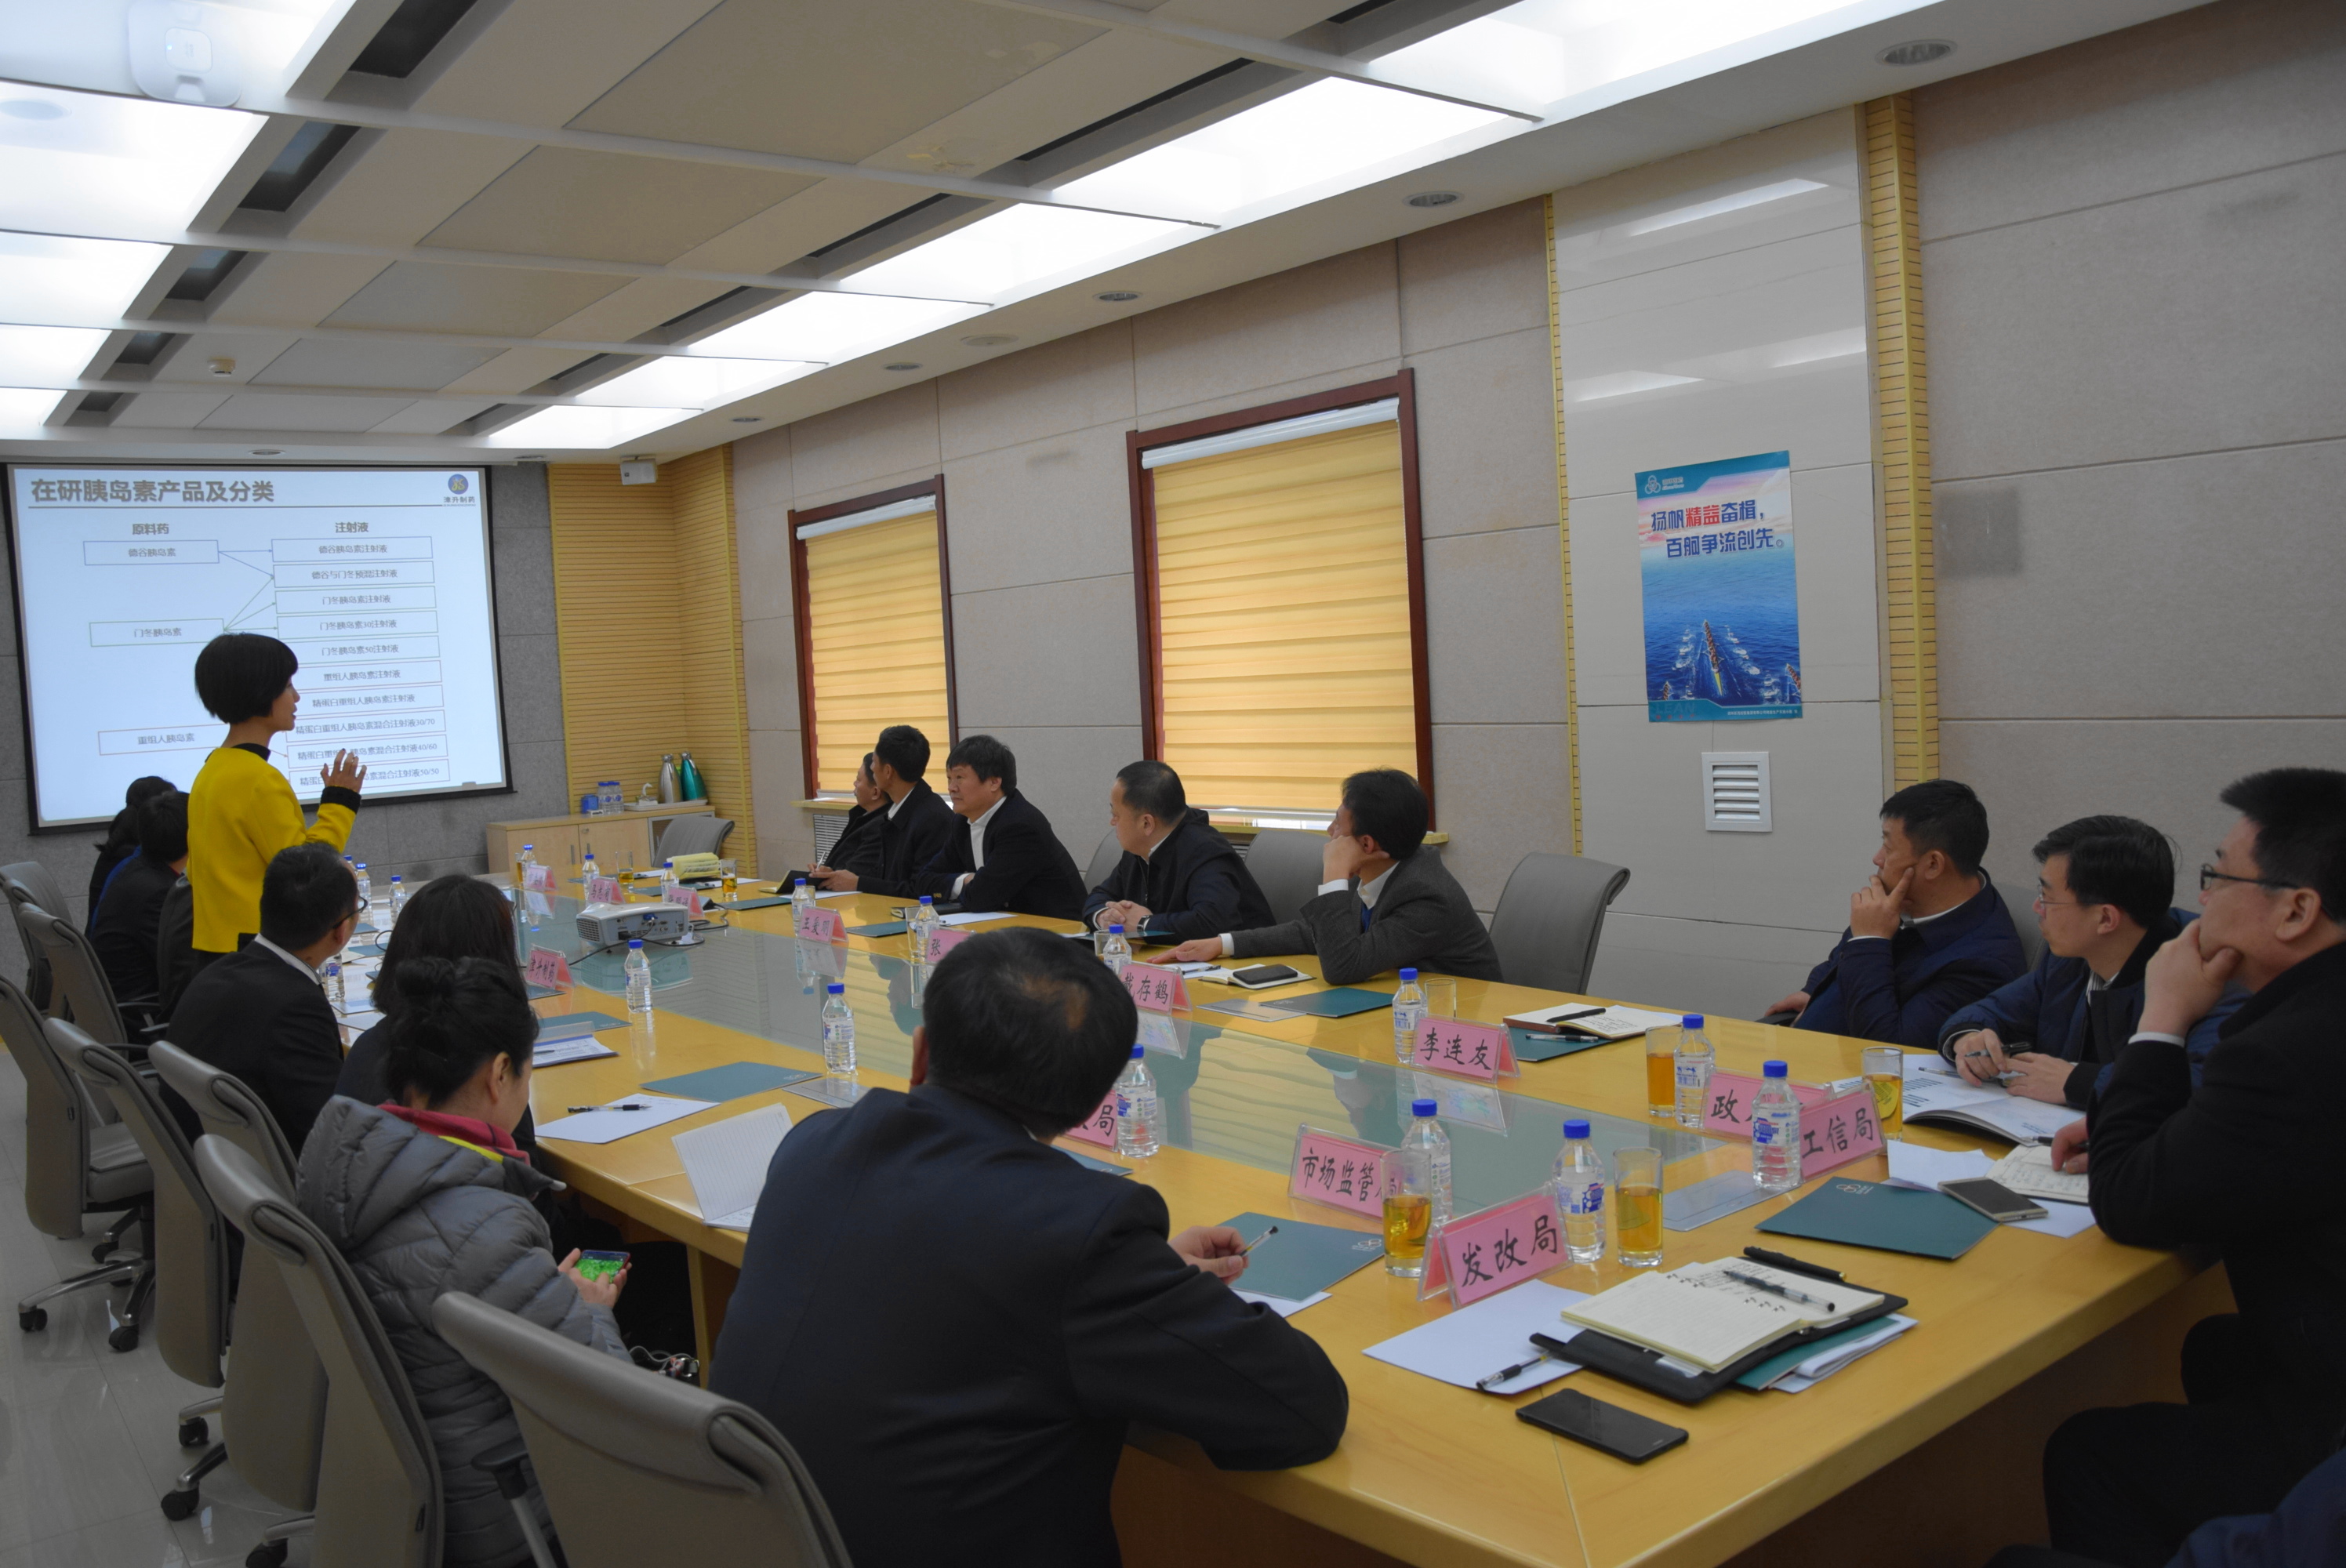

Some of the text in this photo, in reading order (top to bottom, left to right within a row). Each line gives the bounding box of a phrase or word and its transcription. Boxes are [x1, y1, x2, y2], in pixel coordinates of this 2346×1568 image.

[31, 478, 275, 503] 在研胰岛素产品及分类
[132, 523, 169, 535] 原料药
[335, 521, 369, 534] 注射液
[128, 547, 176, 558] 德谷胰岛素
[318, 544, 388, 554] 德谷胰岛素注射液
[311, 568, 398, 580] 德谷与门冬预混注射液
[321, 594, 391, 605] 门冬胰岛素注射液
[319, 619, 398, 631] 门冬胰岛素30注射液
[133, 627, 182, 638] 门冬胰岛素
[321, 644, 399, 656] 门冬胰岛素50注射液
[323, 670, 401, 682] 重组人胰岛素注射液
[1419, 1027, 1492, 1071] 李连友
[1803, 1107, 1874, 1160] 工信局
[1461, 1214, 1559, 1289] 发改局
